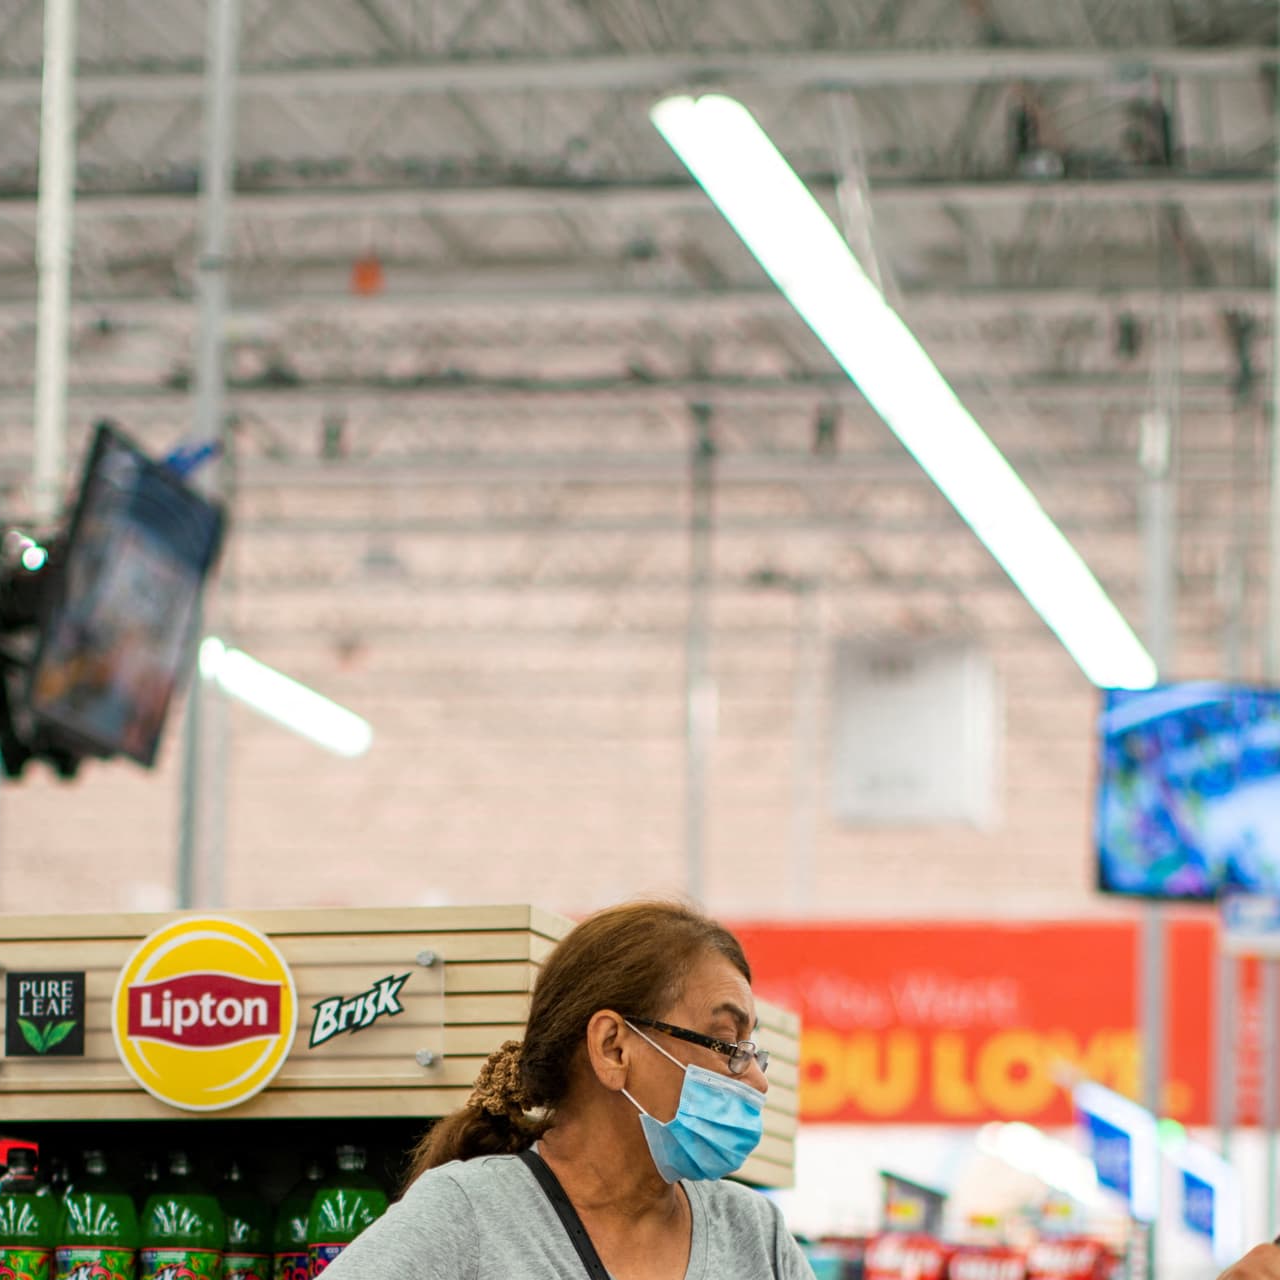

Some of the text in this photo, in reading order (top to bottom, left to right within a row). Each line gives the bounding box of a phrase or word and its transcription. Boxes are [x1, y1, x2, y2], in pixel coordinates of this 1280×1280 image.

[19, 980, 74, 997] PURE
[18, 999, 73, 1017] LEAF
[141, 990, 269, 1036] Lipton
